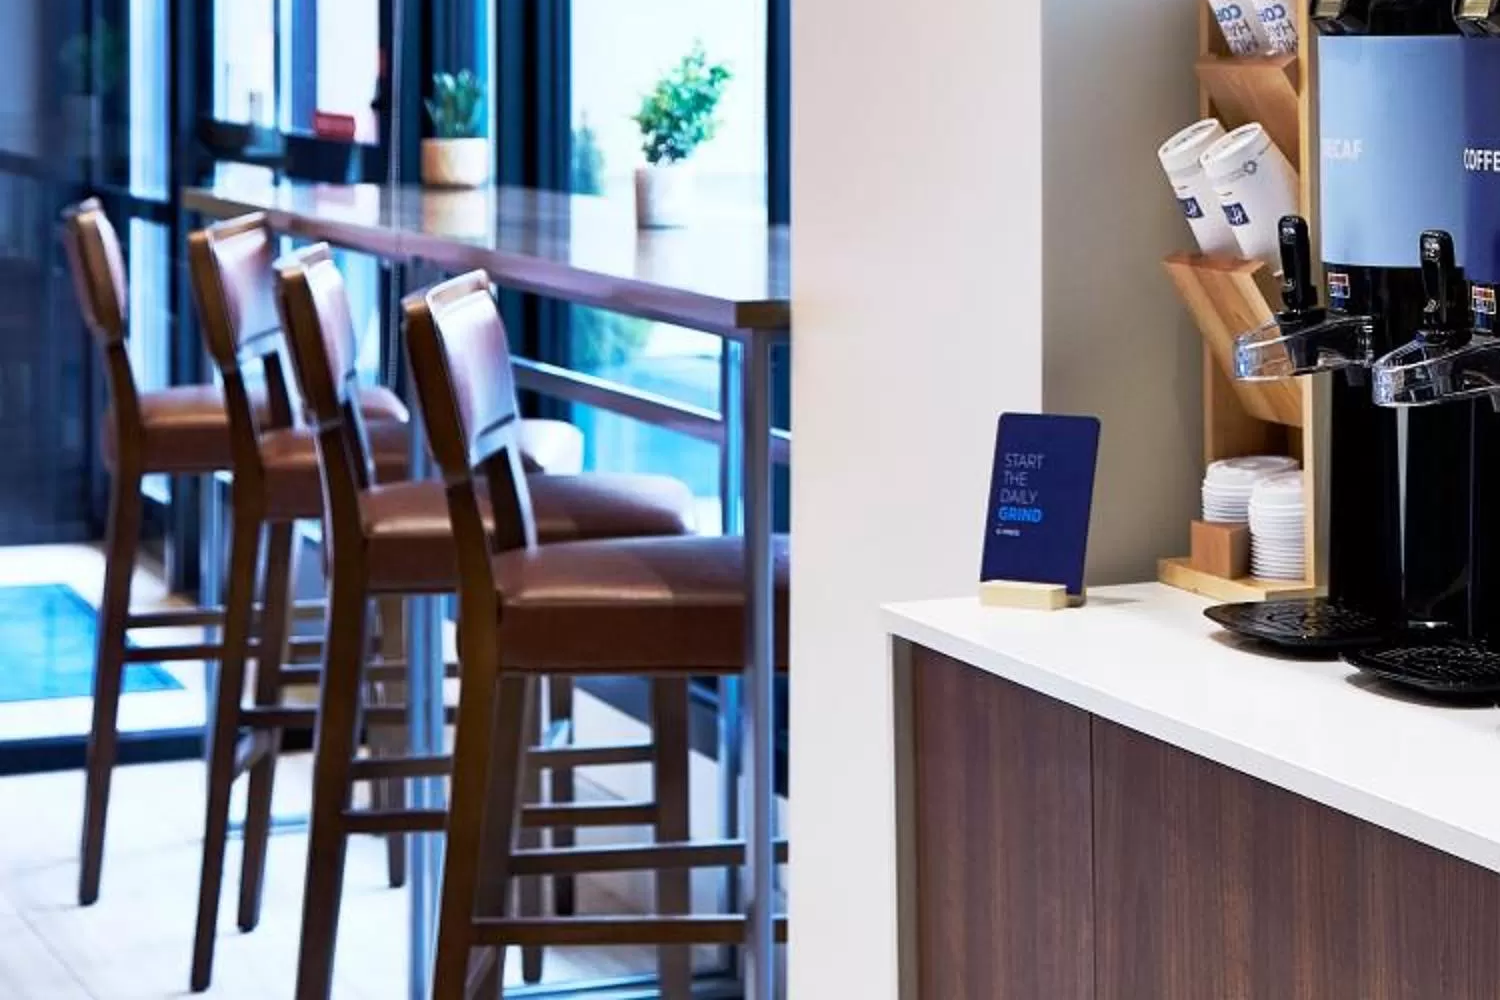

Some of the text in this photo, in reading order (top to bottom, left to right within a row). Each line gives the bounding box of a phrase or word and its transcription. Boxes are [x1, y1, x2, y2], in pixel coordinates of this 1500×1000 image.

[1004, 453, 1045, 469] START
[1003, 470, 1028, 487] THE
[1000, 487, 1038, 505] DAILY
[999, 506, 1042, 523] GRIND
